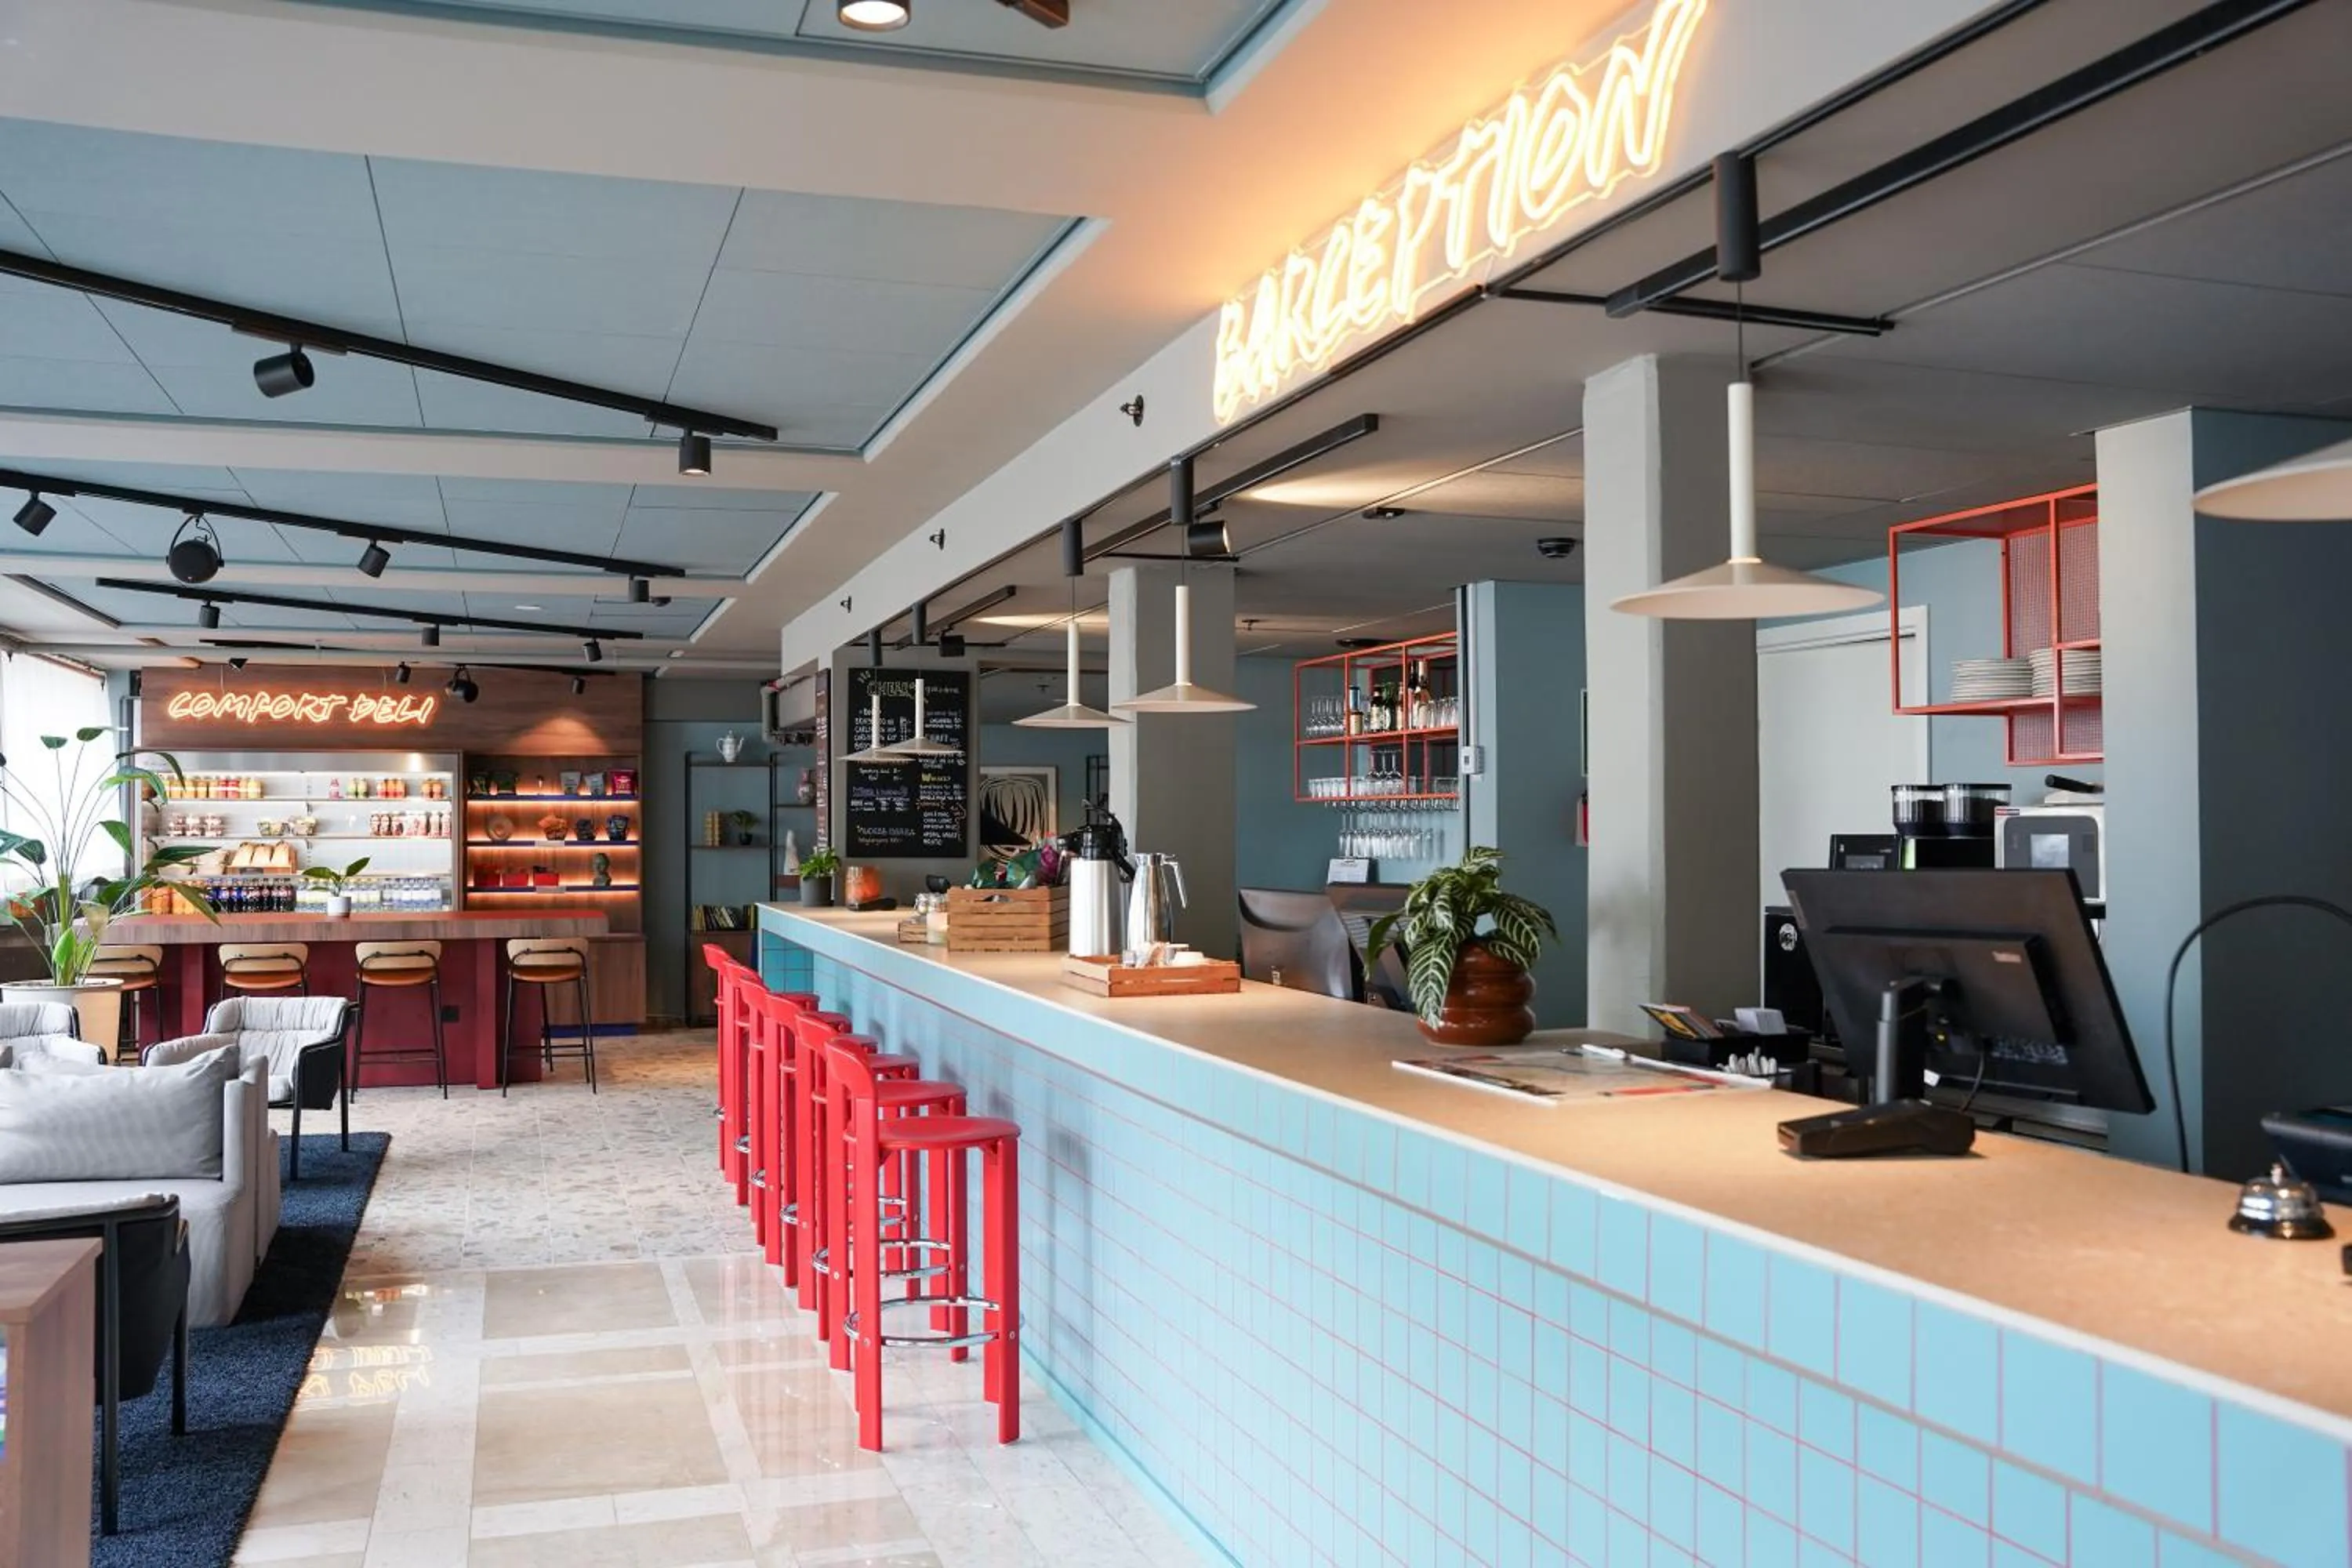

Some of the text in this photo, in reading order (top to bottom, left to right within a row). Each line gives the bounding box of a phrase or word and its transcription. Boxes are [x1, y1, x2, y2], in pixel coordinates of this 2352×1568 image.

[1214, 0, 1708, 423] BARCEPTION
[168, 691, 434, 724] COMFORT DELI
